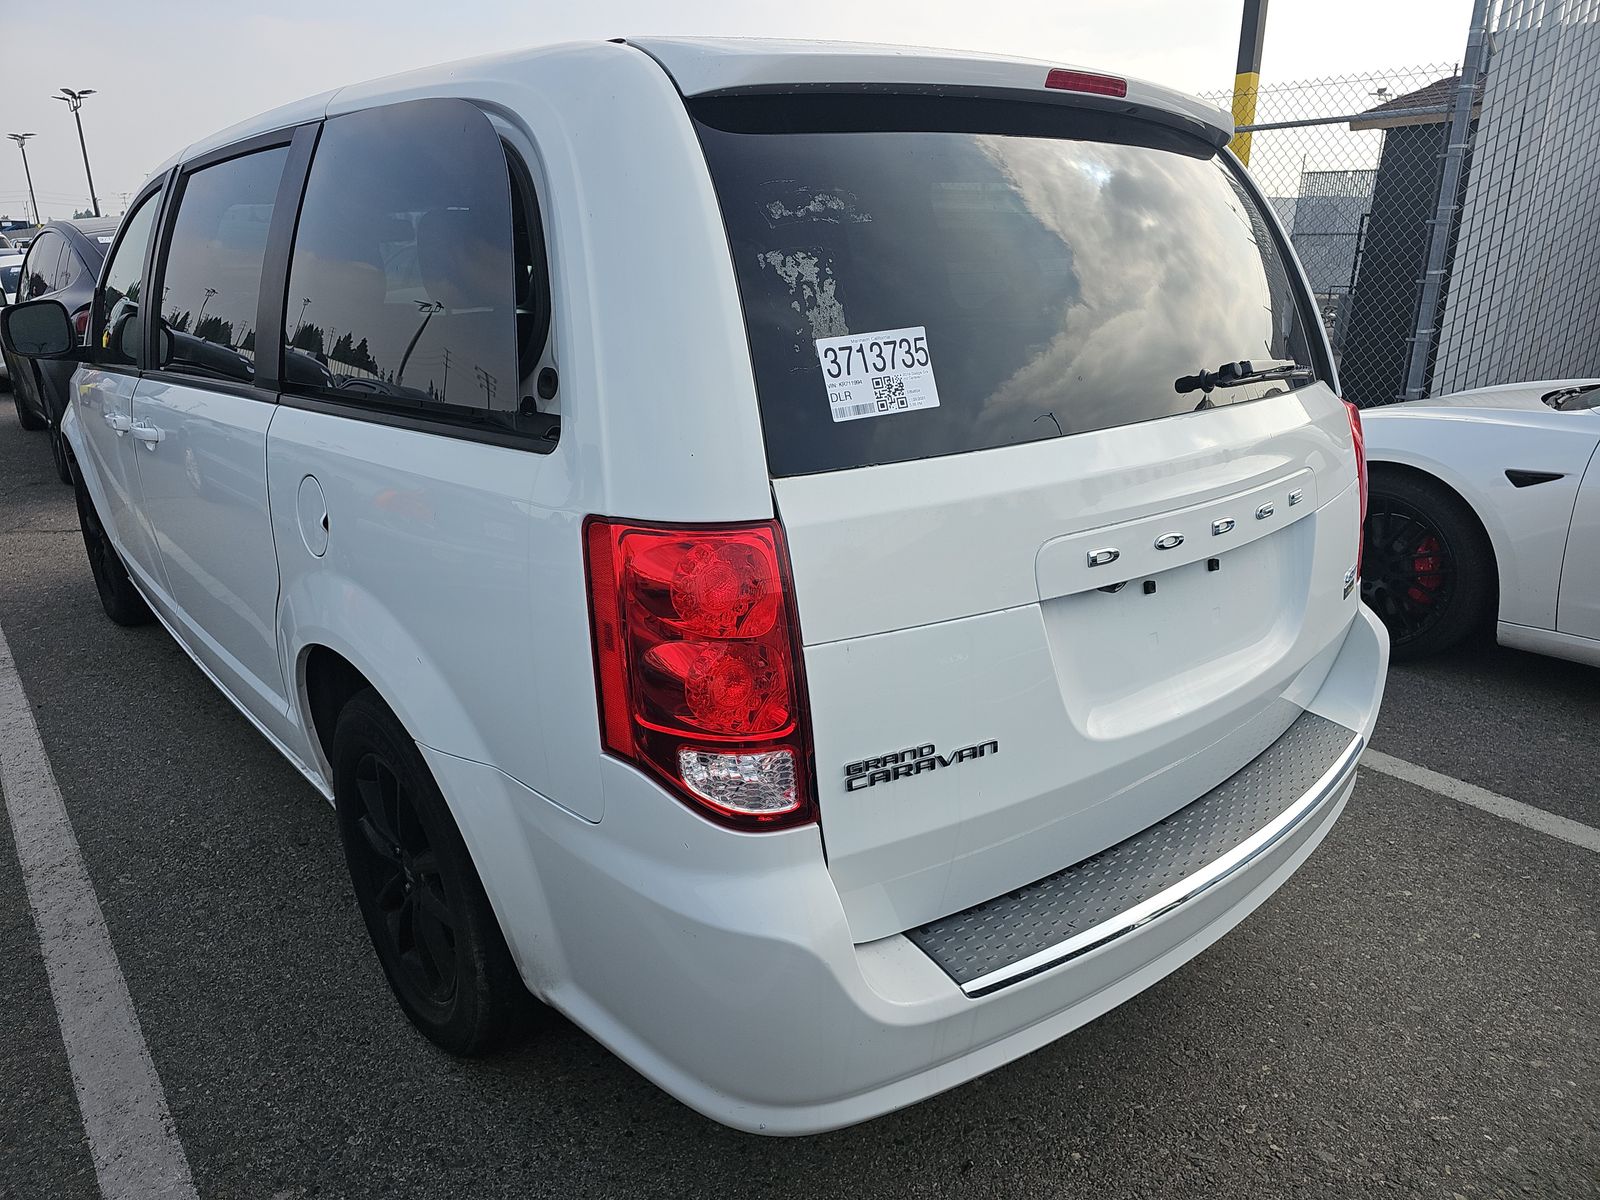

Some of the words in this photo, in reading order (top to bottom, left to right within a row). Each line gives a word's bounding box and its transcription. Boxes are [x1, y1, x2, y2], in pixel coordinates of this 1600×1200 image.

[823, 336, 929, 379] 3713735
[829, 390, 853, 403] DLR
[1086, 488, 1303, 568] DODGE
[843, 742, 936, 777] GRAND
[845, 738, 1000, 792] CARAVAN
